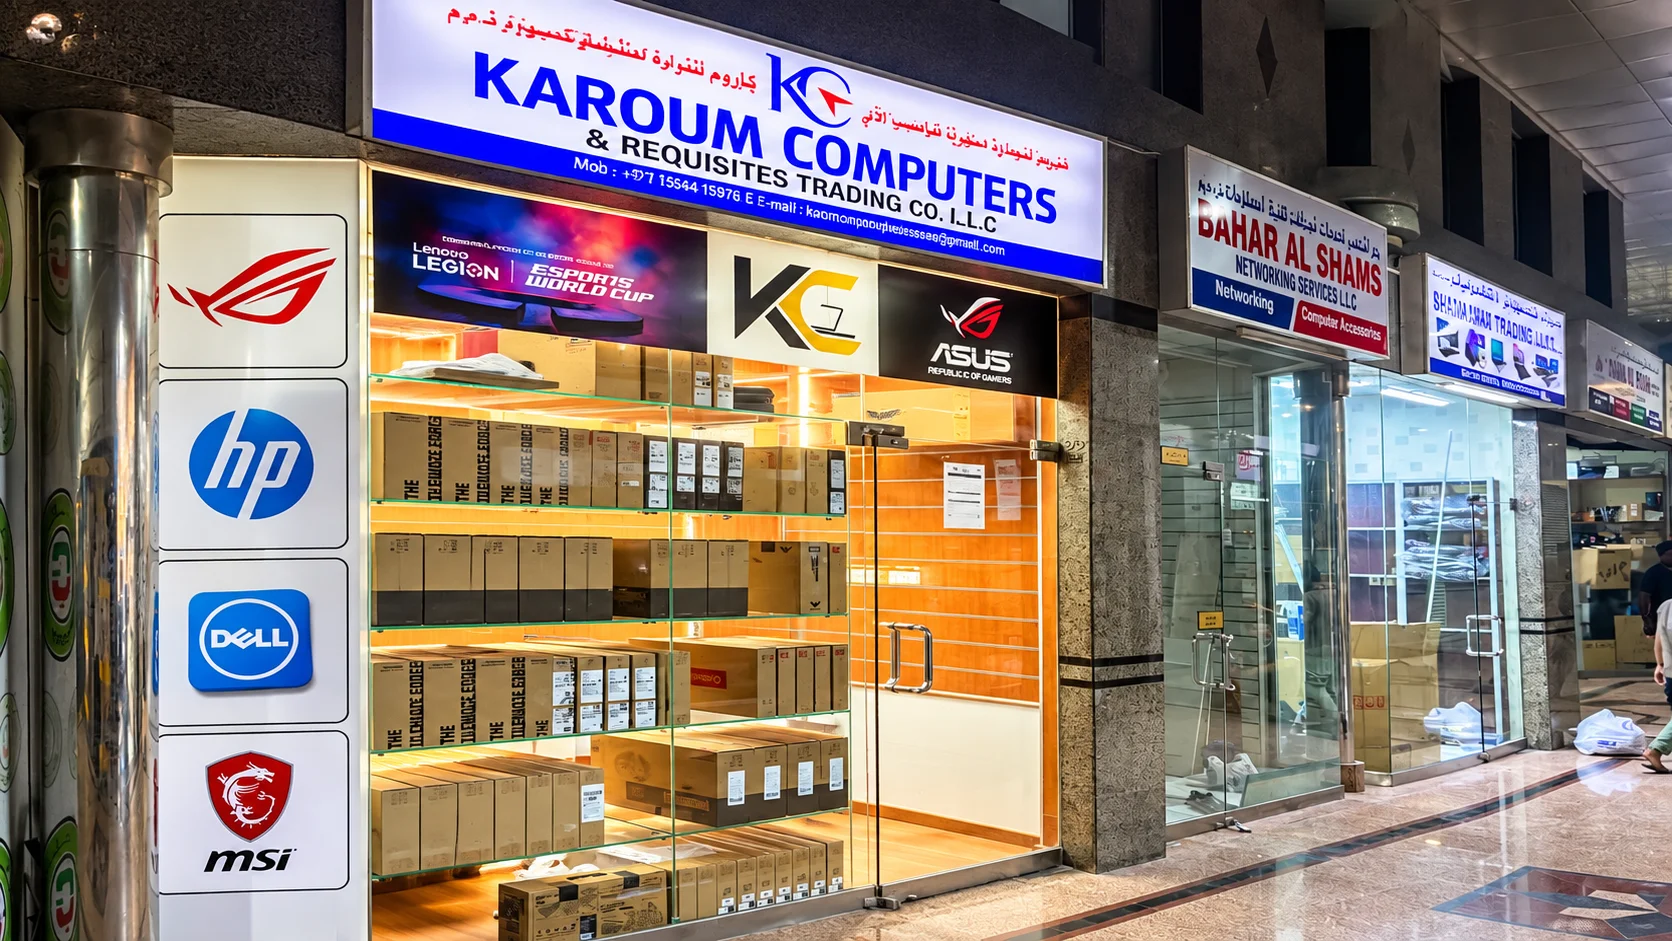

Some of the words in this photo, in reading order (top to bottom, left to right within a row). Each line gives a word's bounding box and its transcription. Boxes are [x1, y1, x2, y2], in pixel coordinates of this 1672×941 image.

[474, 51, 763, 159] KAROUM
[783, 126, 1057, 224] COMPUTERS
[573, 156, 608, 174] Mob
[586, 128, 609, 151] &
[621, 135, 788, 189] REQUISITES
[796, 173, 901, 213] TRADING
[909, 199, 943, 222] CO.
[1197, 197, 1279, 263] BAHAR
[1284, 232, 1311, 273] AL
[1317, 243, 1382, 297] SHAMS
[413, 254, 499, 281] LEGION
[1235, 254, 1296, 292] NETWORKING
[1298, 275, 1338, 305] SERVICES
[1340, 290, 1357, 311] LLC
[525, 275, 608, 297] WORLD
[609, 288, 655, 303] CUP
[1215, 279, 1274, 315] Networking
[1301, 306, 1338, 329] Computer
[1494, 314, 1533, 345] TRADING
[930, 342, 1011, 373] ASUS
[203, 408, 302, 519] hp
[211, 627, 289, 649] DELL
[204, 848, 293, 873] msi
